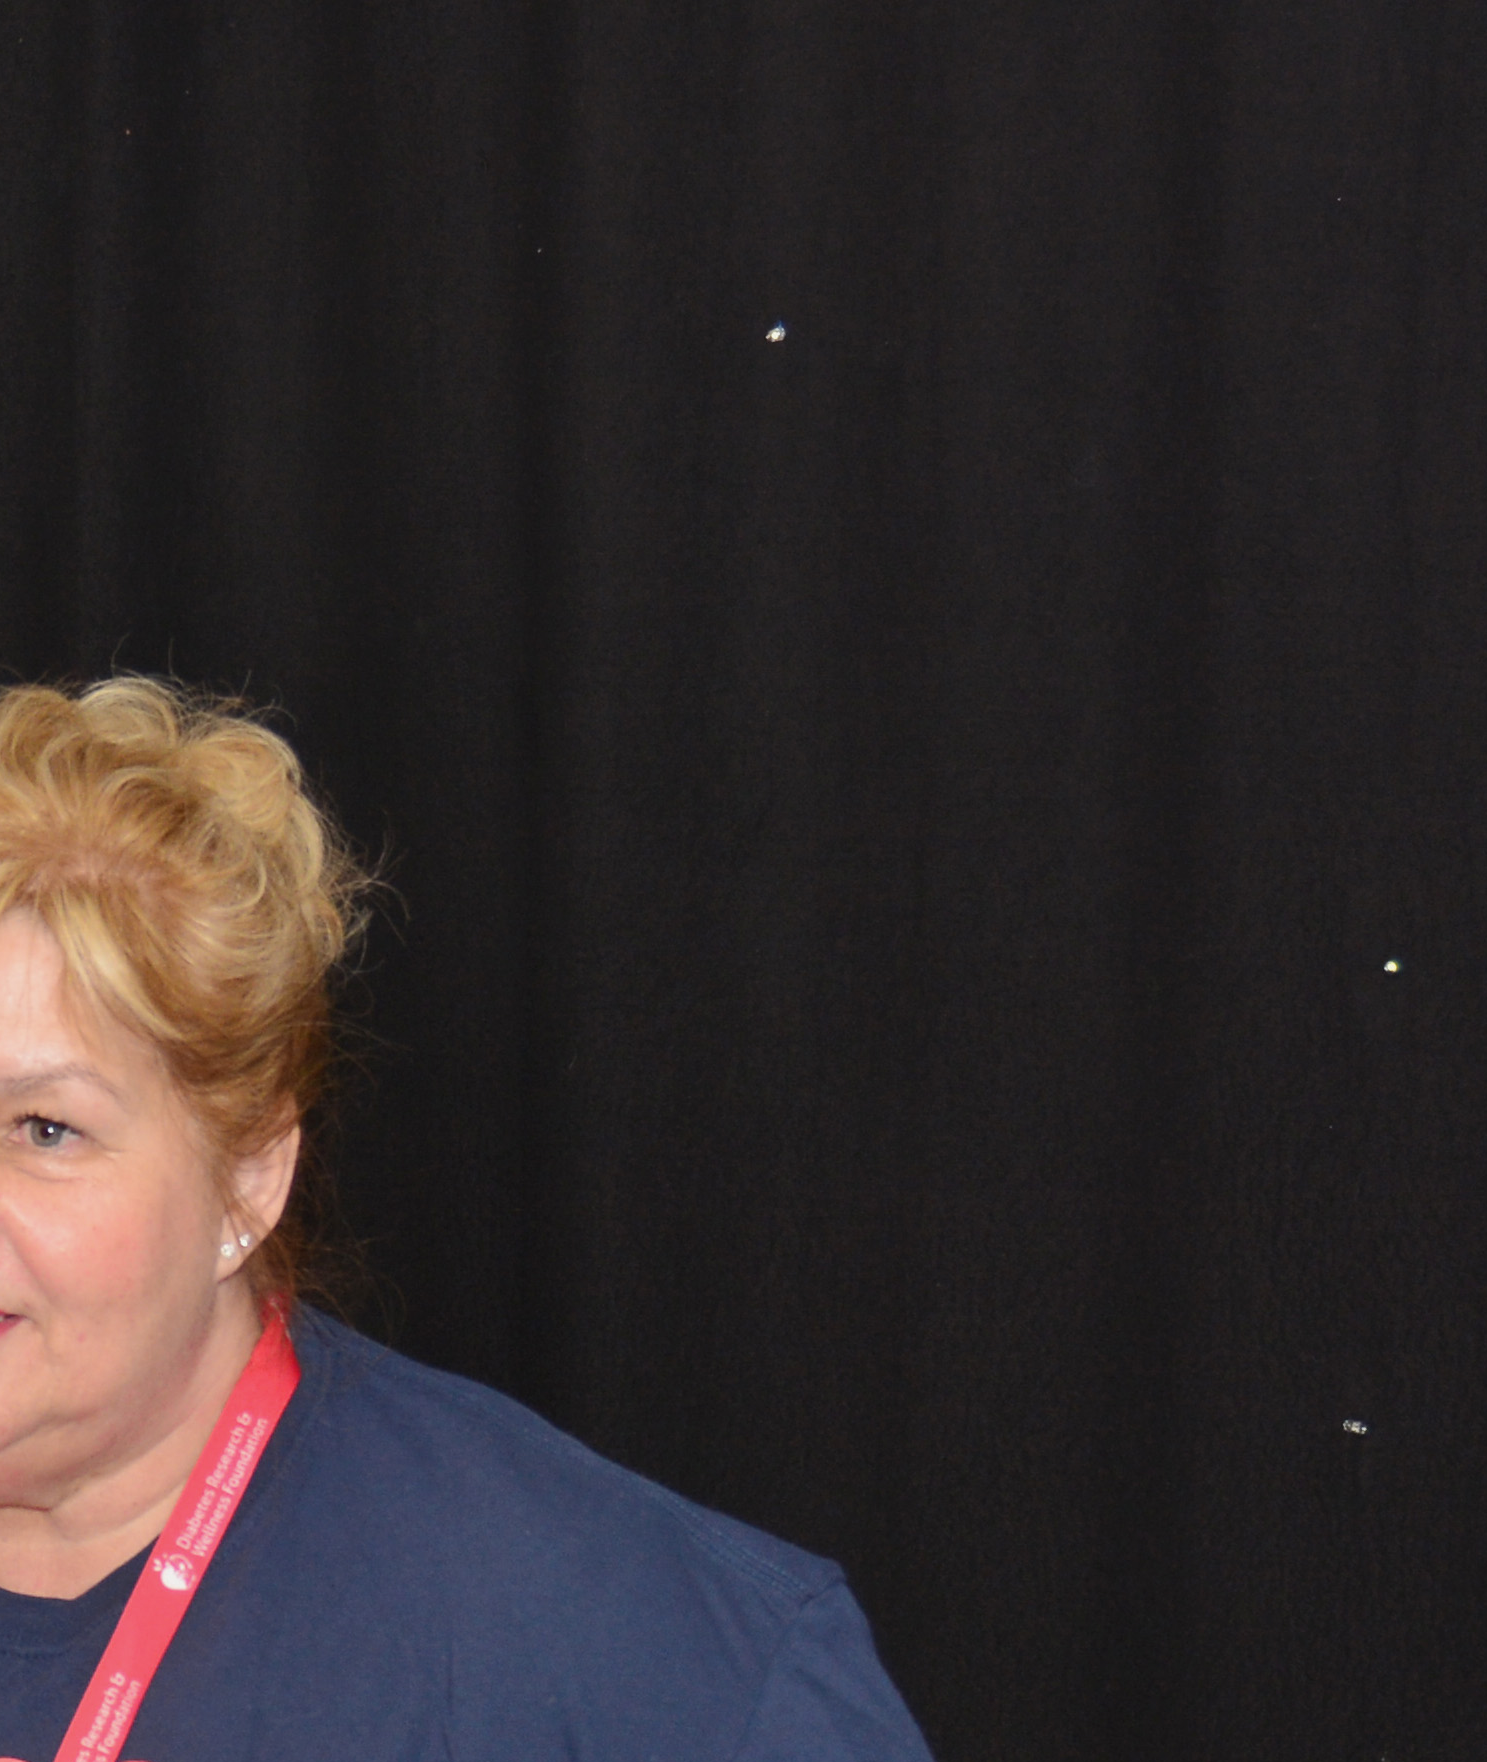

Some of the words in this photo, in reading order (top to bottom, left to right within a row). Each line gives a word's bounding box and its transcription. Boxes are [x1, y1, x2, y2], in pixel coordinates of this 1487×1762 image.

[176, 1488, 215, 1550] Diabetes
[205, 1427, 245, 1488] Research
[236, 1412, 252, 1426] &
[190, 1496, 231, 1557] Wellness
[222, 1418, 268, 1495] Foundation
[80, 1687, 119, 1749] Research
[110, 1672, 126, 1687] &
[97, 1680, 141, 1754] Foundation
